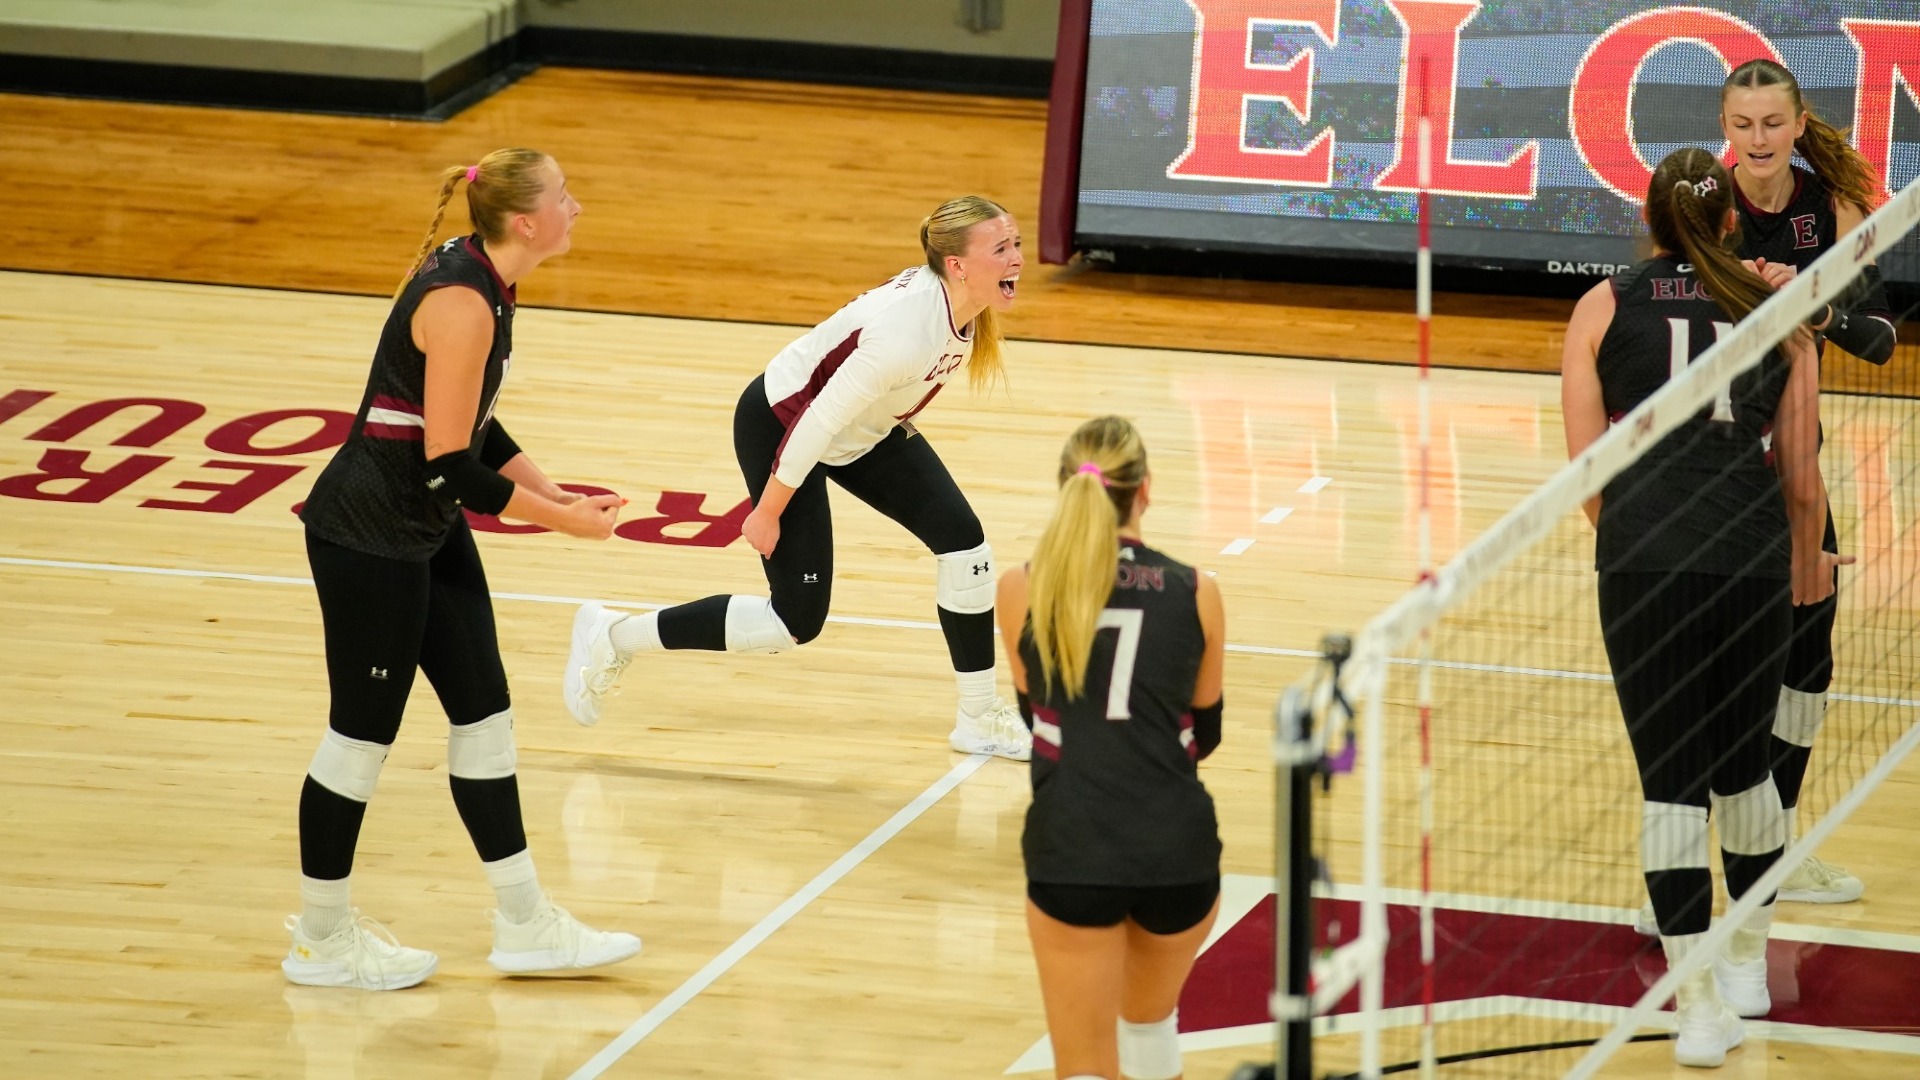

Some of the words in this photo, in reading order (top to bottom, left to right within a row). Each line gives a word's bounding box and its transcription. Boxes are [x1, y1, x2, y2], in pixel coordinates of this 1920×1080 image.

[1790, 214, 1819, 250] E
[1650, 277, 1716, 302] ELO
[0, 389, 360, 457] OU
[1115, 564, 1166, 593] ON
[1096, 608, 1145, 721] 7
